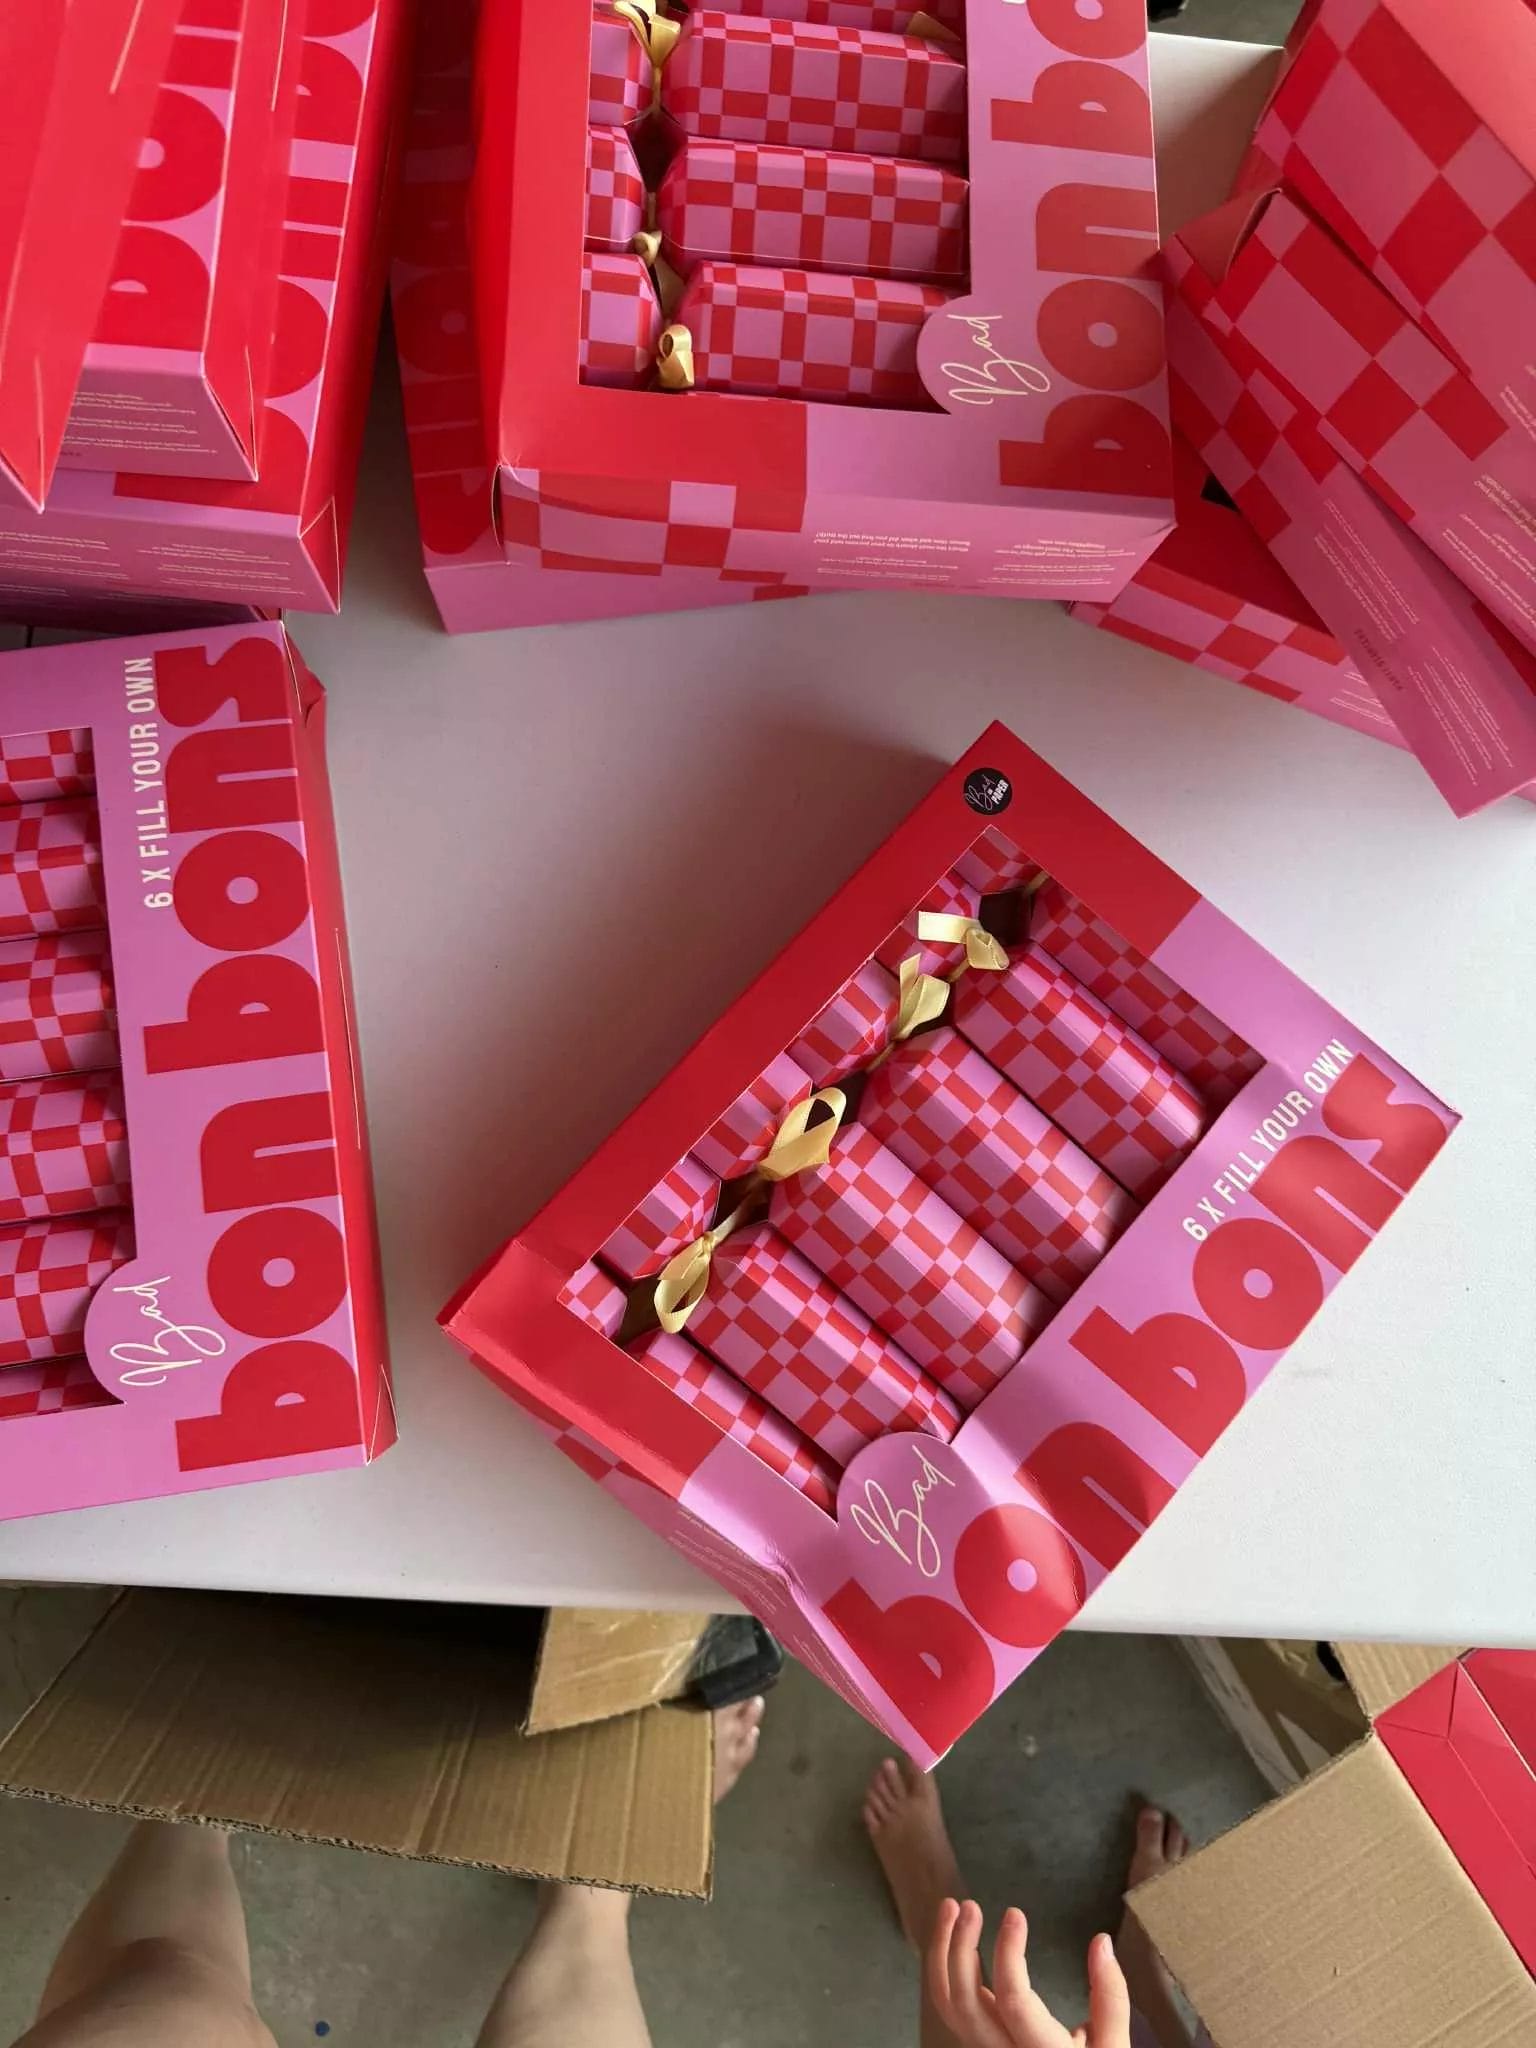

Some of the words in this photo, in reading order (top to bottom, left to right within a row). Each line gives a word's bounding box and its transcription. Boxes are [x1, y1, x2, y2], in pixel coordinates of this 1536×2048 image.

[941, 313, 1050, 405] Bad
[1000, 183, 1173, 498] bon
[124, 657, 156, 713] OWN
[130, 722, 163, 793] YOUR
[991, 779, 1009, 805] PAPER
[136, 799, 169, 858] FILL
[142, 866, 172, 884] X
[143, 637, 328, 1075] bons
[144, 891, 173, 908] 6
[1182, 1216, 1208, 1242] 6
[1196, 1196, 1226, 1224] X
[1212, 1151, 1265, 1205] FILL
[1250, 1090, 1314, 1153] YOUR
[1303, 1038, 1354, 1094] OWN
[110, 1276, 226, 1386] Bad
[177, 1092, 362, 1472] bon
[821, 1422, 1178, 1758] bon
[1068, 1053, 1448, 1459] bons
[850, 1444, 956, 1577] Bad
